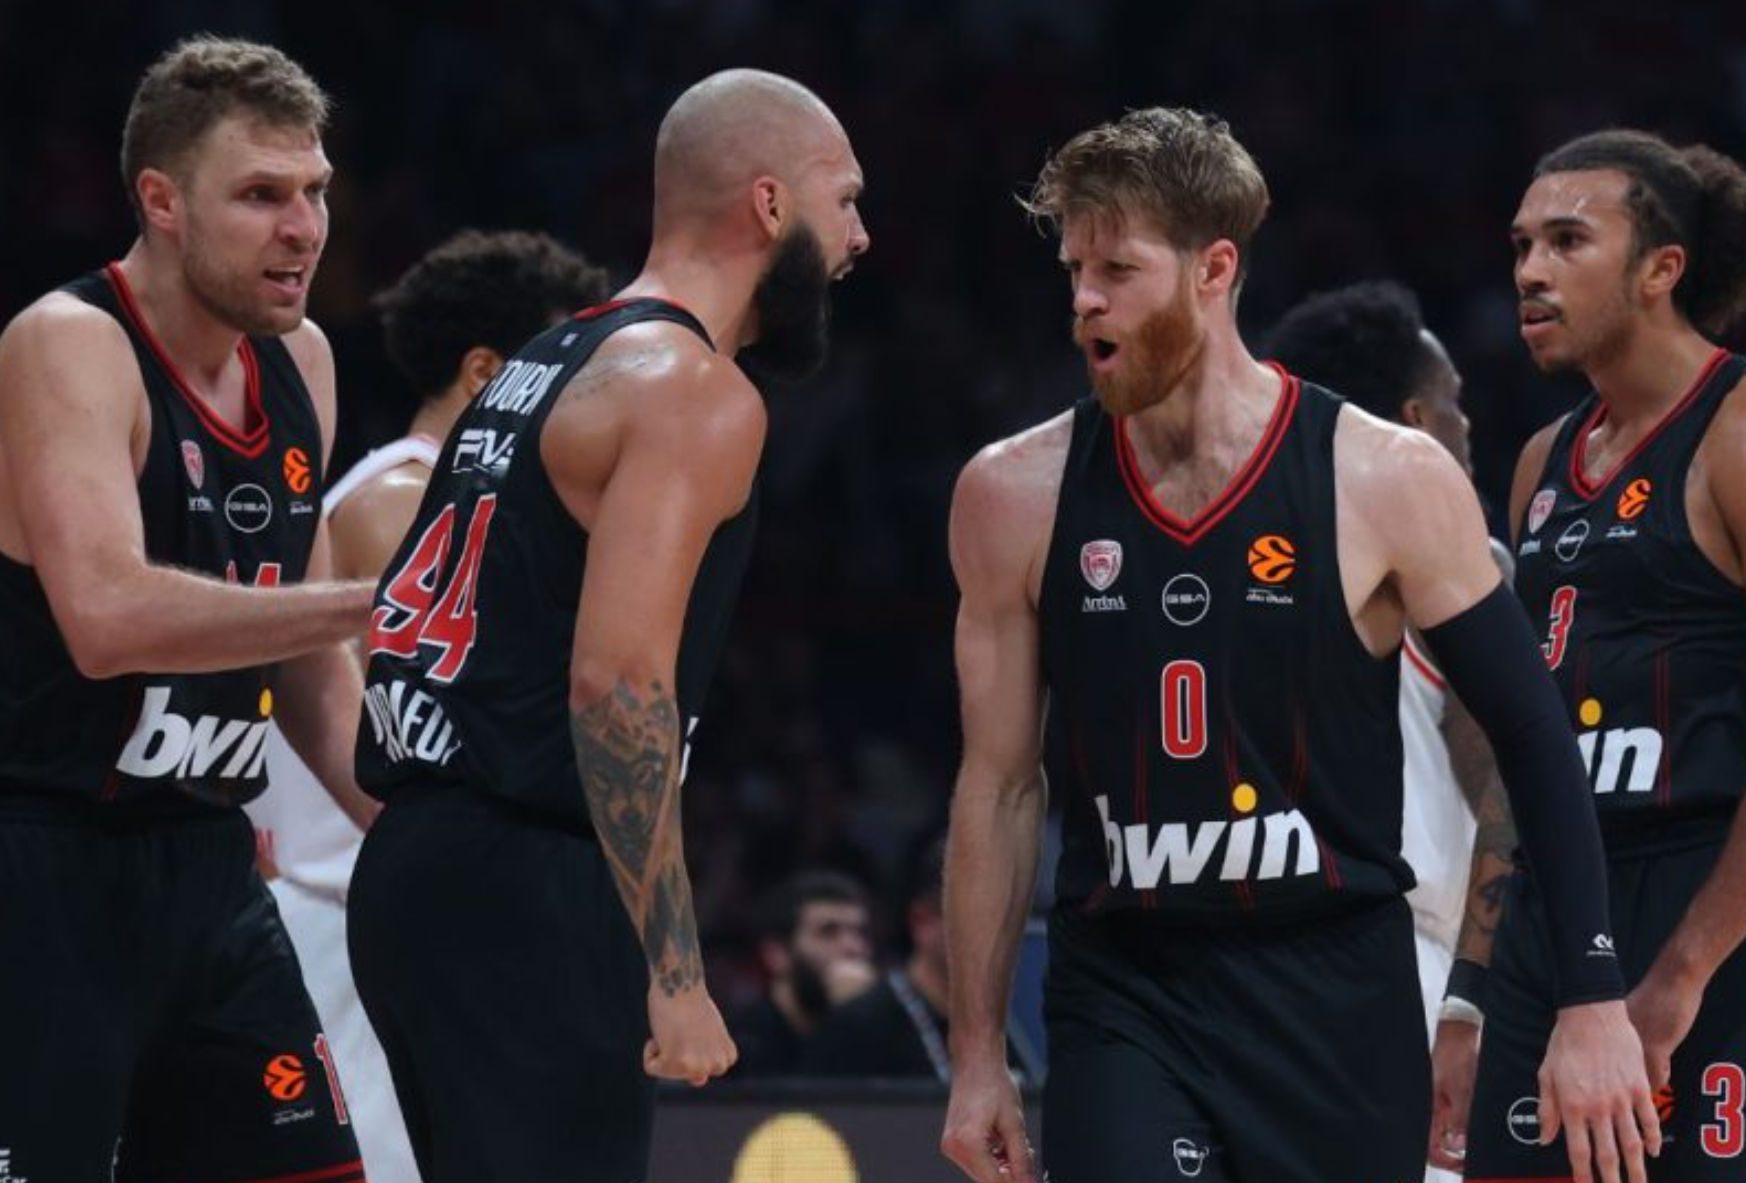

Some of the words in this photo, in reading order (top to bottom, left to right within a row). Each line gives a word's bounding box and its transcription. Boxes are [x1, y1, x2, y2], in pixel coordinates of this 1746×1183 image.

[1540, 585, 1578, 672] 3
[1161, 659, 1207, 759] 0
[1094, 783, 1320, 890] bwin
[1701, 1062, 1746, 1158] 3
